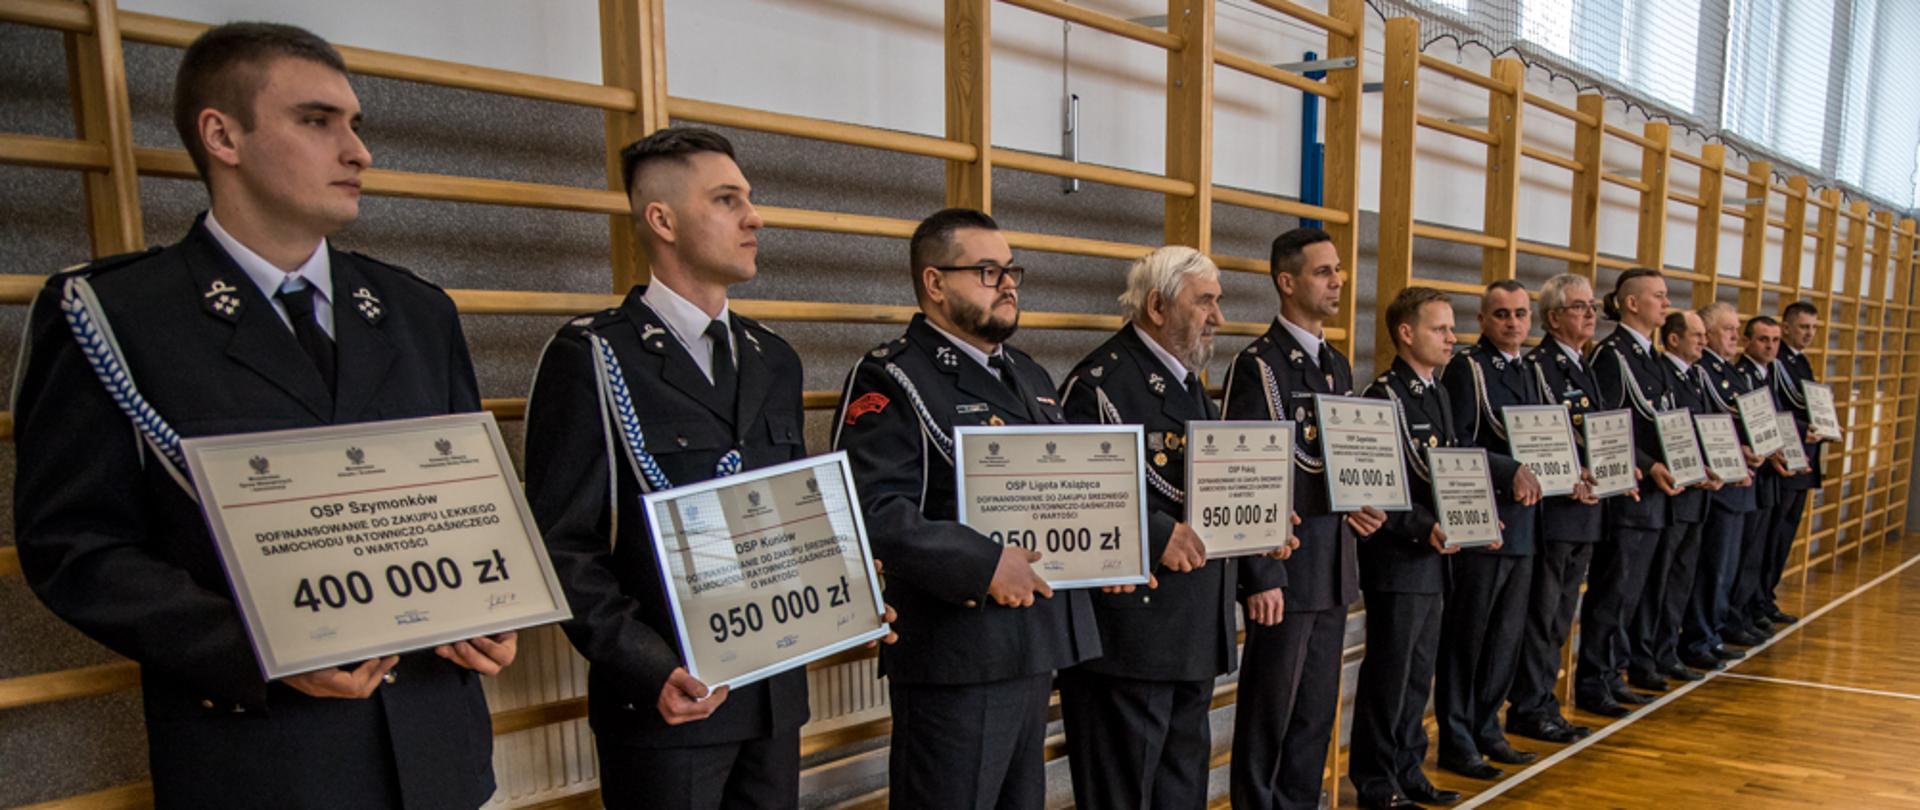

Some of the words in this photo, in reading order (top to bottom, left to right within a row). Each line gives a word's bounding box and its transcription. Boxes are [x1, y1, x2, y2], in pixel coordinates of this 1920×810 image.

[1005, 480, 1026, 491] OSP
[1029, 479, 1058, 492] Ligota
[1339, 468, 1359, 486] 400
[1362, 469, 1382, 487] 000
[1385, 470, 1396, 487] zł
[310, 503, 344, 519] OSP
[348, 494, 438, 515] Szymonków
[1203, 506, 1230, 527] 950
[1235, 504, 1261, 525] 000
[1265, 503, 1277, 523] zł
[1446, 510, 1463, 526] 950
[255, 520, 370, 543] DOFINANSOWANIE
[371, 517, 389, 528] DO
[392, 511, 438, 525] ZAKUPU
[440, 503, 496, 519] LEKKIEGO
[261, 538, 344, 556] SAMOCHODU
[346, 514, 500, 544] RATOWNICZO-GAŚNICZEGO
[353, 547, 364, 556] O
[365, 537, 429, 554] WARTOŚCI
[735, 539, 758, 554] OSP
[760, 531, 796, 548] Kuniów
[1045, 527, 1092, 552] 000
[1099, 526, 1121, 550] zł
[686, 557, 759, 584] DOINANSOWANIE
[761, 554, 773, 564] DO
[774, 548, 804, 560] ZAKUPU
[293, 570, 374, 612] 400
[385, 556, 463, 598] 000
[473, 548, 510, 585] zł
[751, 581, 758, 589] O
[709, 602, 763, 643] 950
[771, 585, 820, 624] 000
[827, 575, 852, 608] zł
